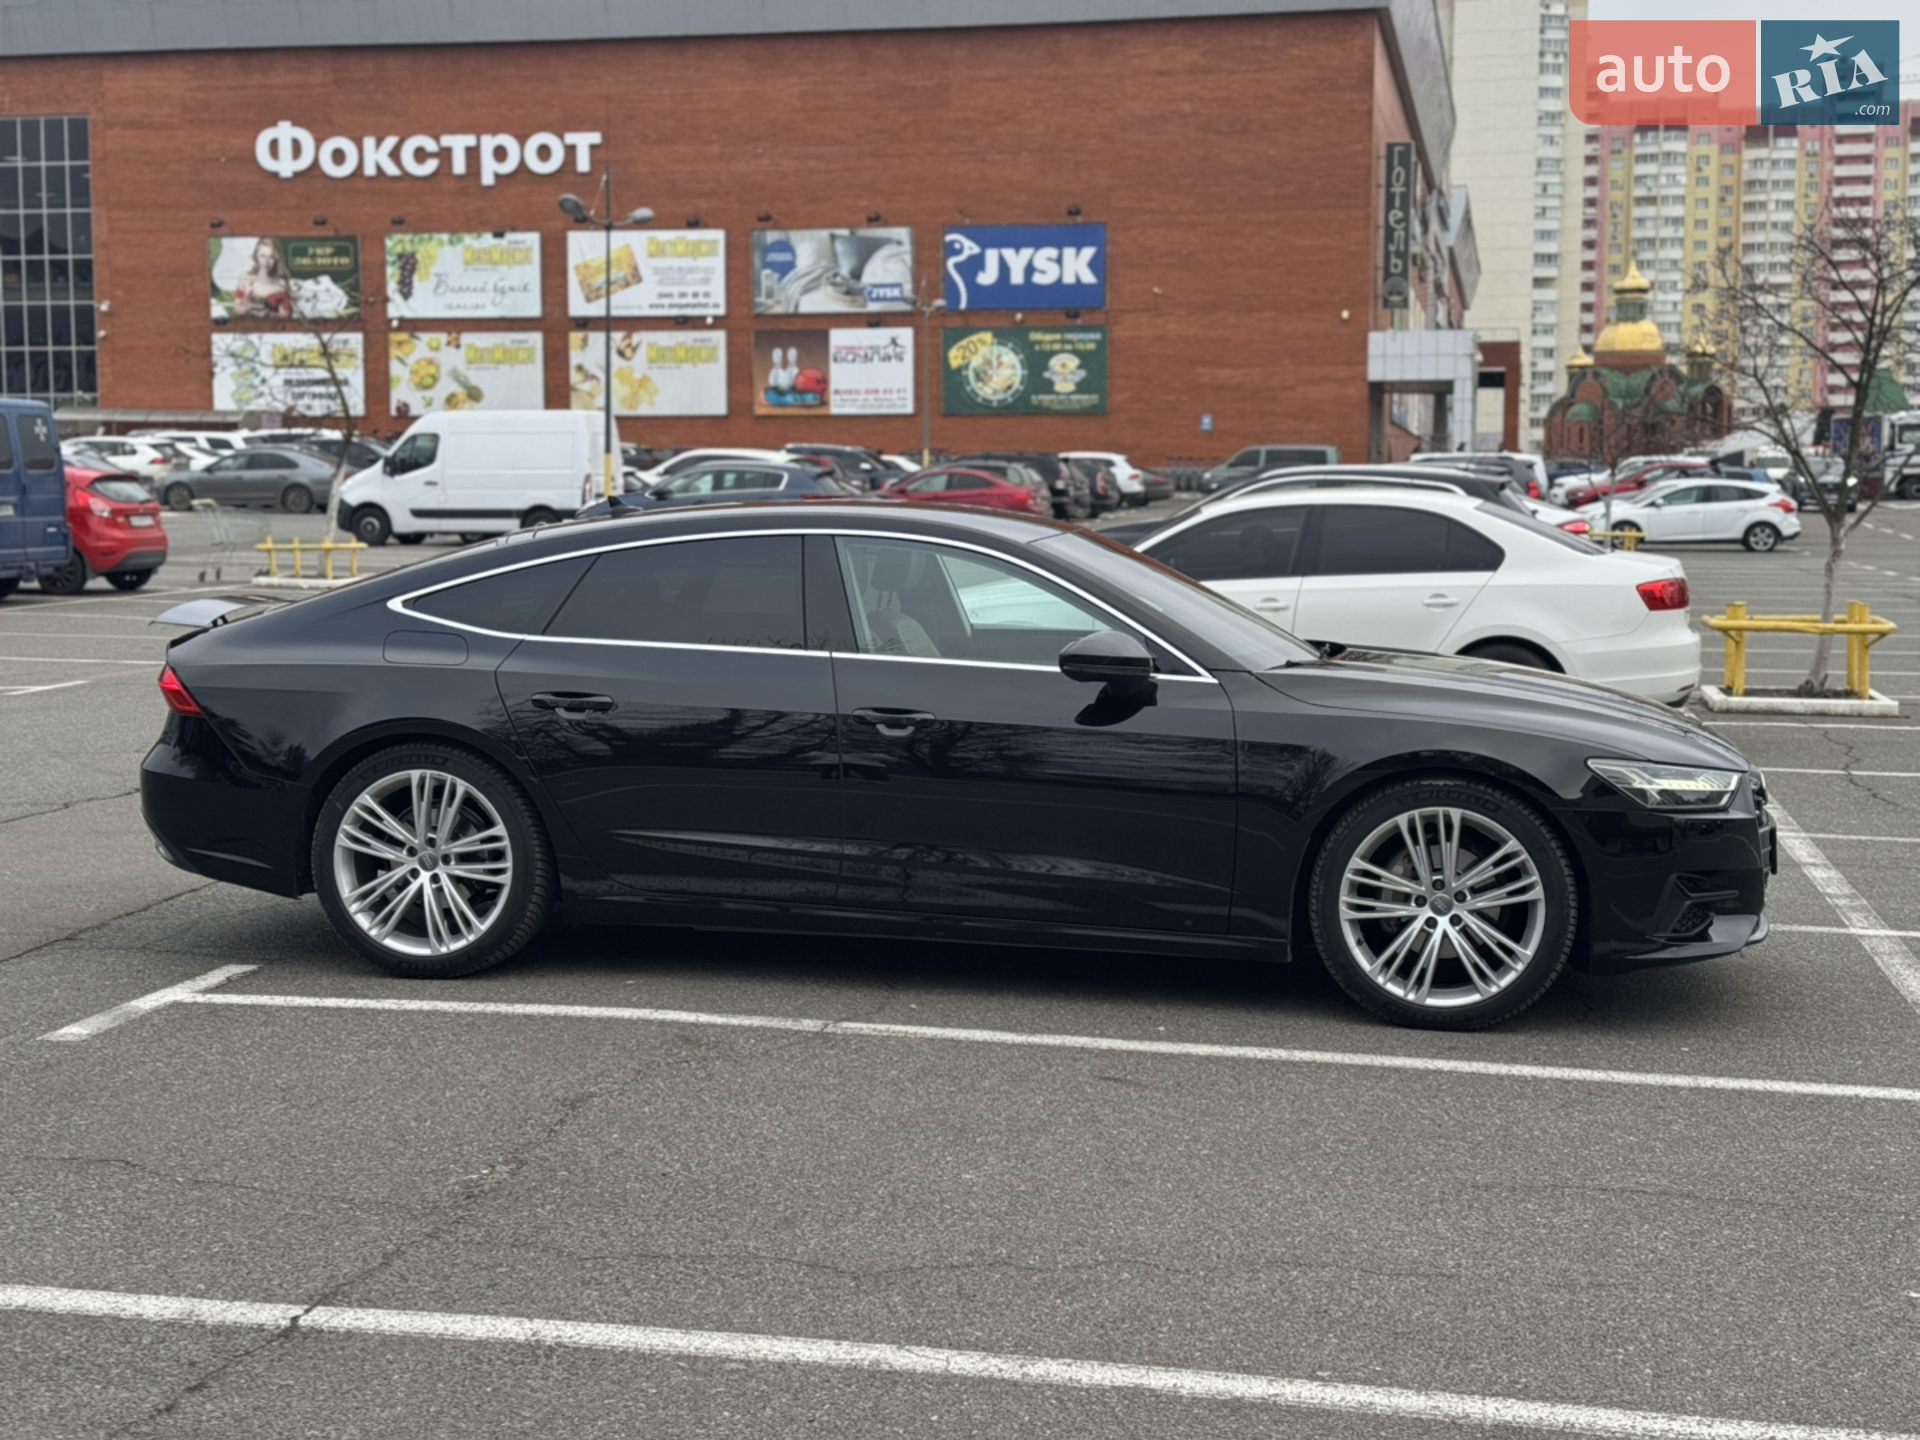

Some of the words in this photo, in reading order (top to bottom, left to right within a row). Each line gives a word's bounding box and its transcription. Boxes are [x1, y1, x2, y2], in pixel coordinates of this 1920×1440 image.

[255, 120, 602, 186] Фокстрот
[975, 246, 1098, 286] JYSK
[871, 286, 902, 300] JYSK
[1417, 791, 1497, 811] MICHELIN
